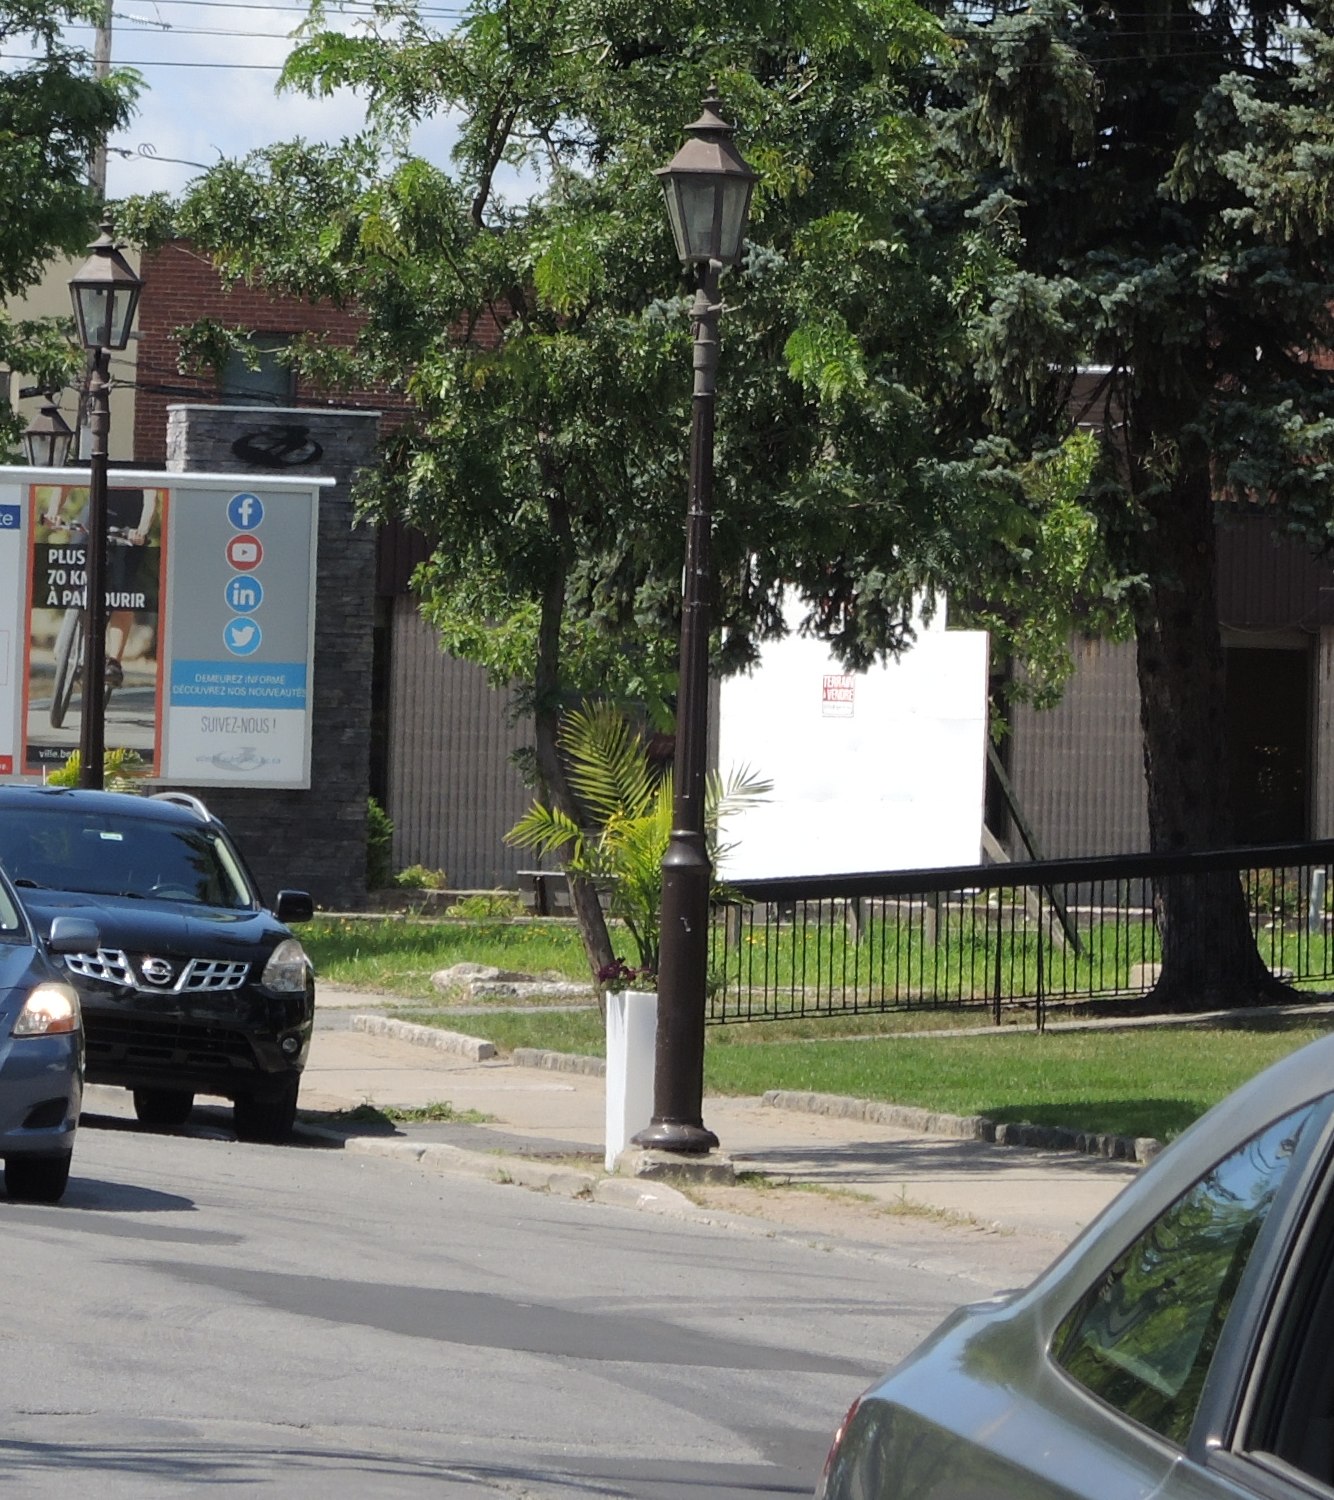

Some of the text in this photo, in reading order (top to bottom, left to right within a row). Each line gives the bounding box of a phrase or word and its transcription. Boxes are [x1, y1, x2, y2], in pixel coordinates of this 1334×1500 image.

[49, 549, 85, 565] PLUS
[48, 569, 66, 586] 70
[47, 586, 145, 608] À PAURIR
[195, 673, 243, 684] DEMEUREZ
[823, 675, 854, 688] TERRAIN
[172, 684, 226, 696] DÉCOUVREZ
[228, 687, 247, 696] NOS
[827, 689, 854, 701] VENDRE
[201, 716, 269, 734] SUIVEZ-NOUS
